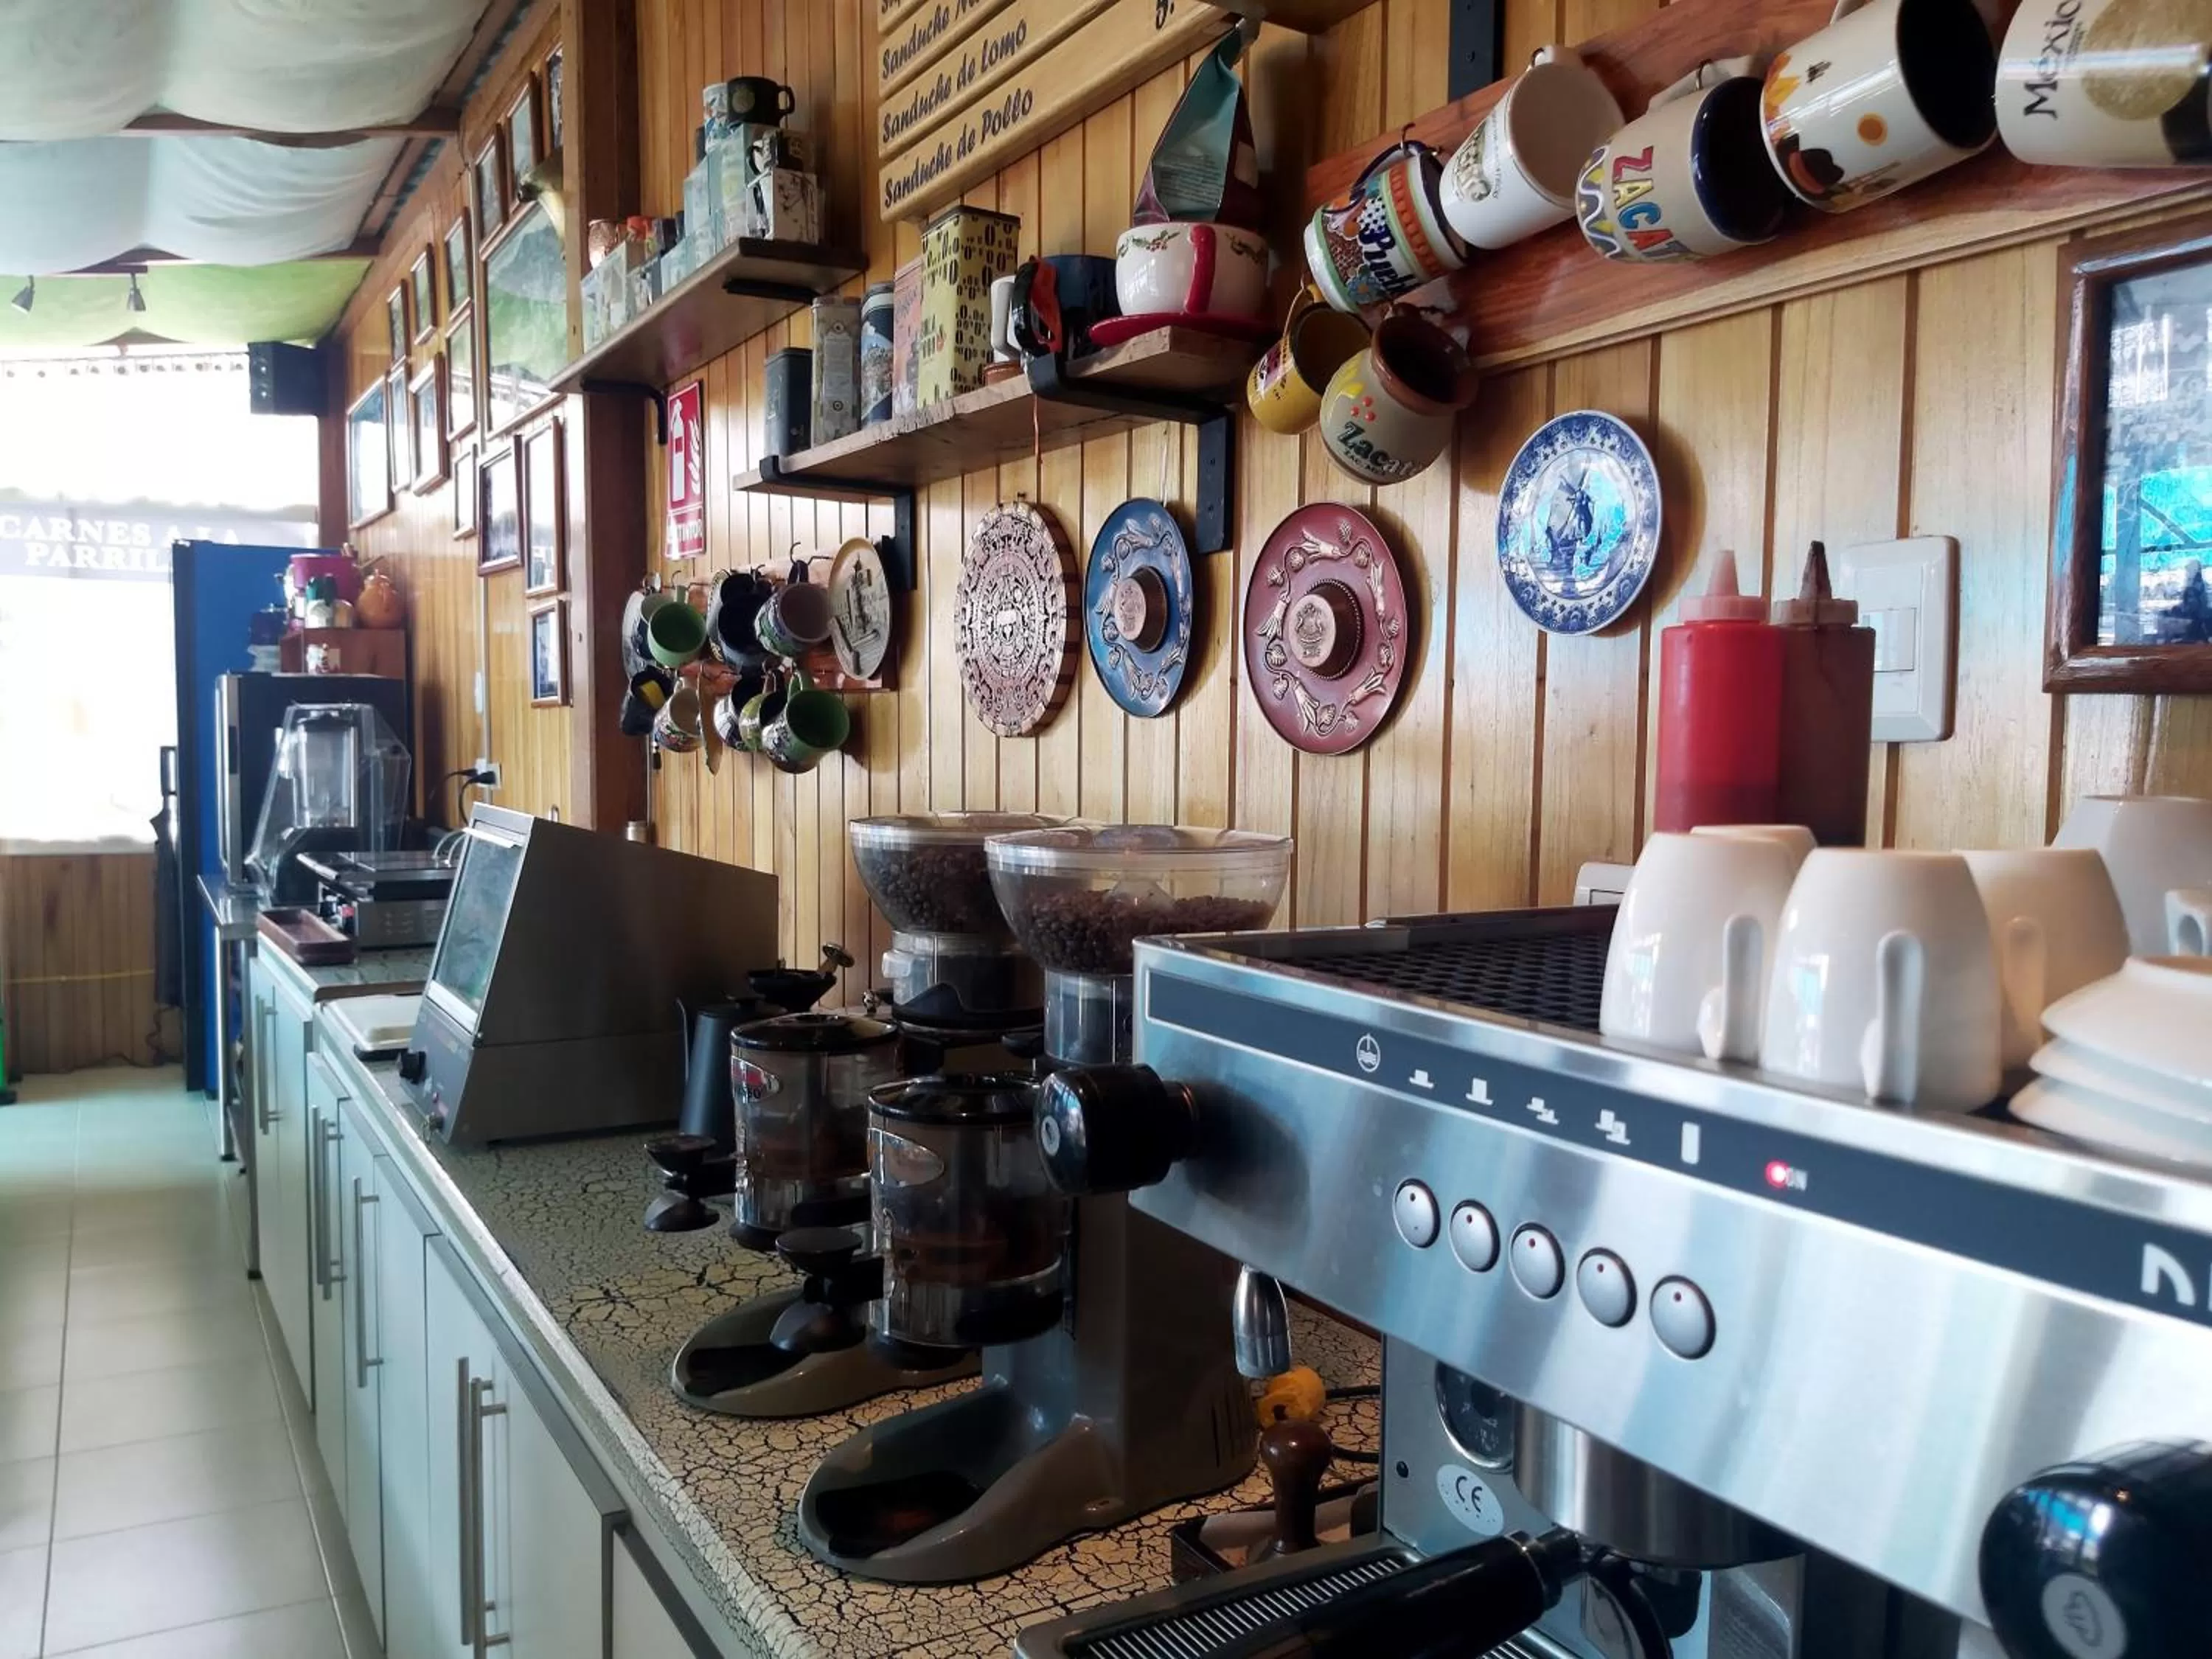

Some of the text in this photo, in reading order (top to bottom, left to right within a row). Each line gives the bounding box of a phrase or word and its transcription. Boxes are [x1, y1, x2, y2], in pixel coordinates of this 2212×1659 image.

[883, 72, 952, 143] Sanduche
[957, 52, 976, 91] de
[885, 88, 1033, 208] Sanduche de Pollo
[0, 515, 153, 546] CARNES
[1455, 1475, 1483, 1513] CE
